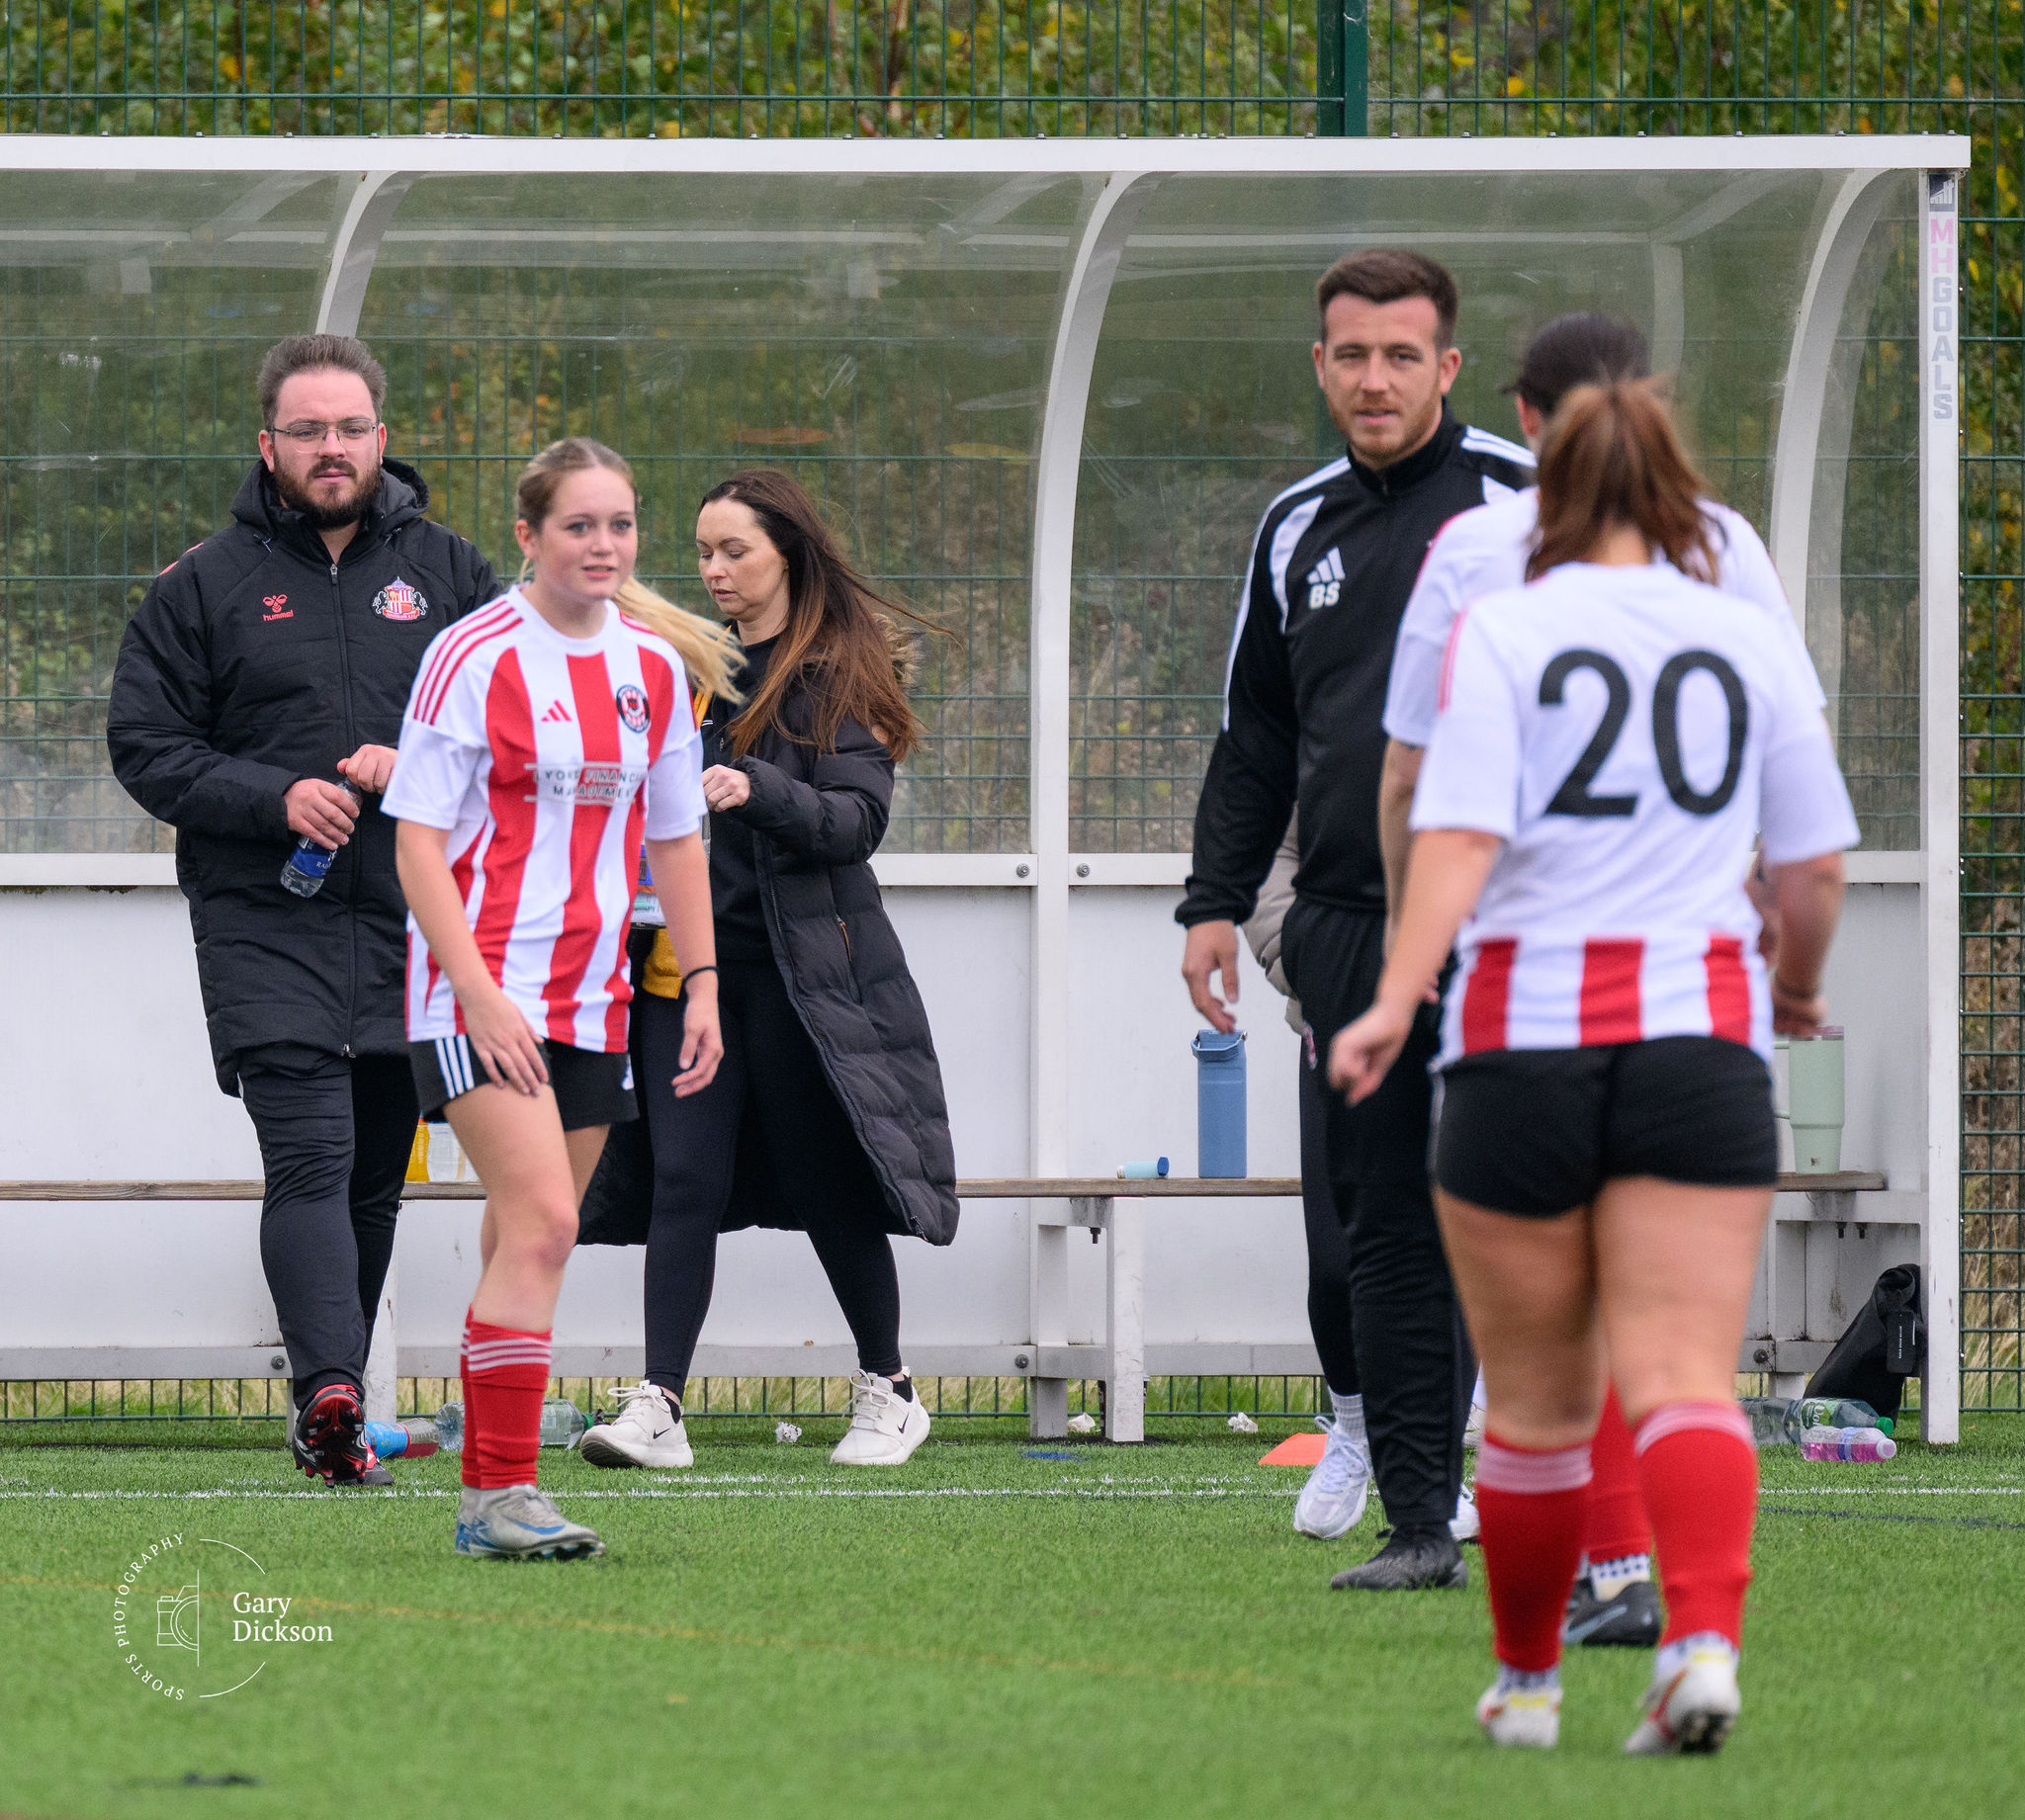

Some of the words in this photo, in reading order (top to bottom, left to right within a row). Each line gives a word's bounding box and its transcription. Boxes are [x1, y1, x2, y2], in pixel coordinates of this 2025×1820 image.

[1309, 580, 1341, 609] BS
[263, 609, 294, 621] hummel
[1539, 649, 1748, 818] 20
[585, 769, 645, 784] FINANC
[554, 784, 635, 798] MAAGEM
